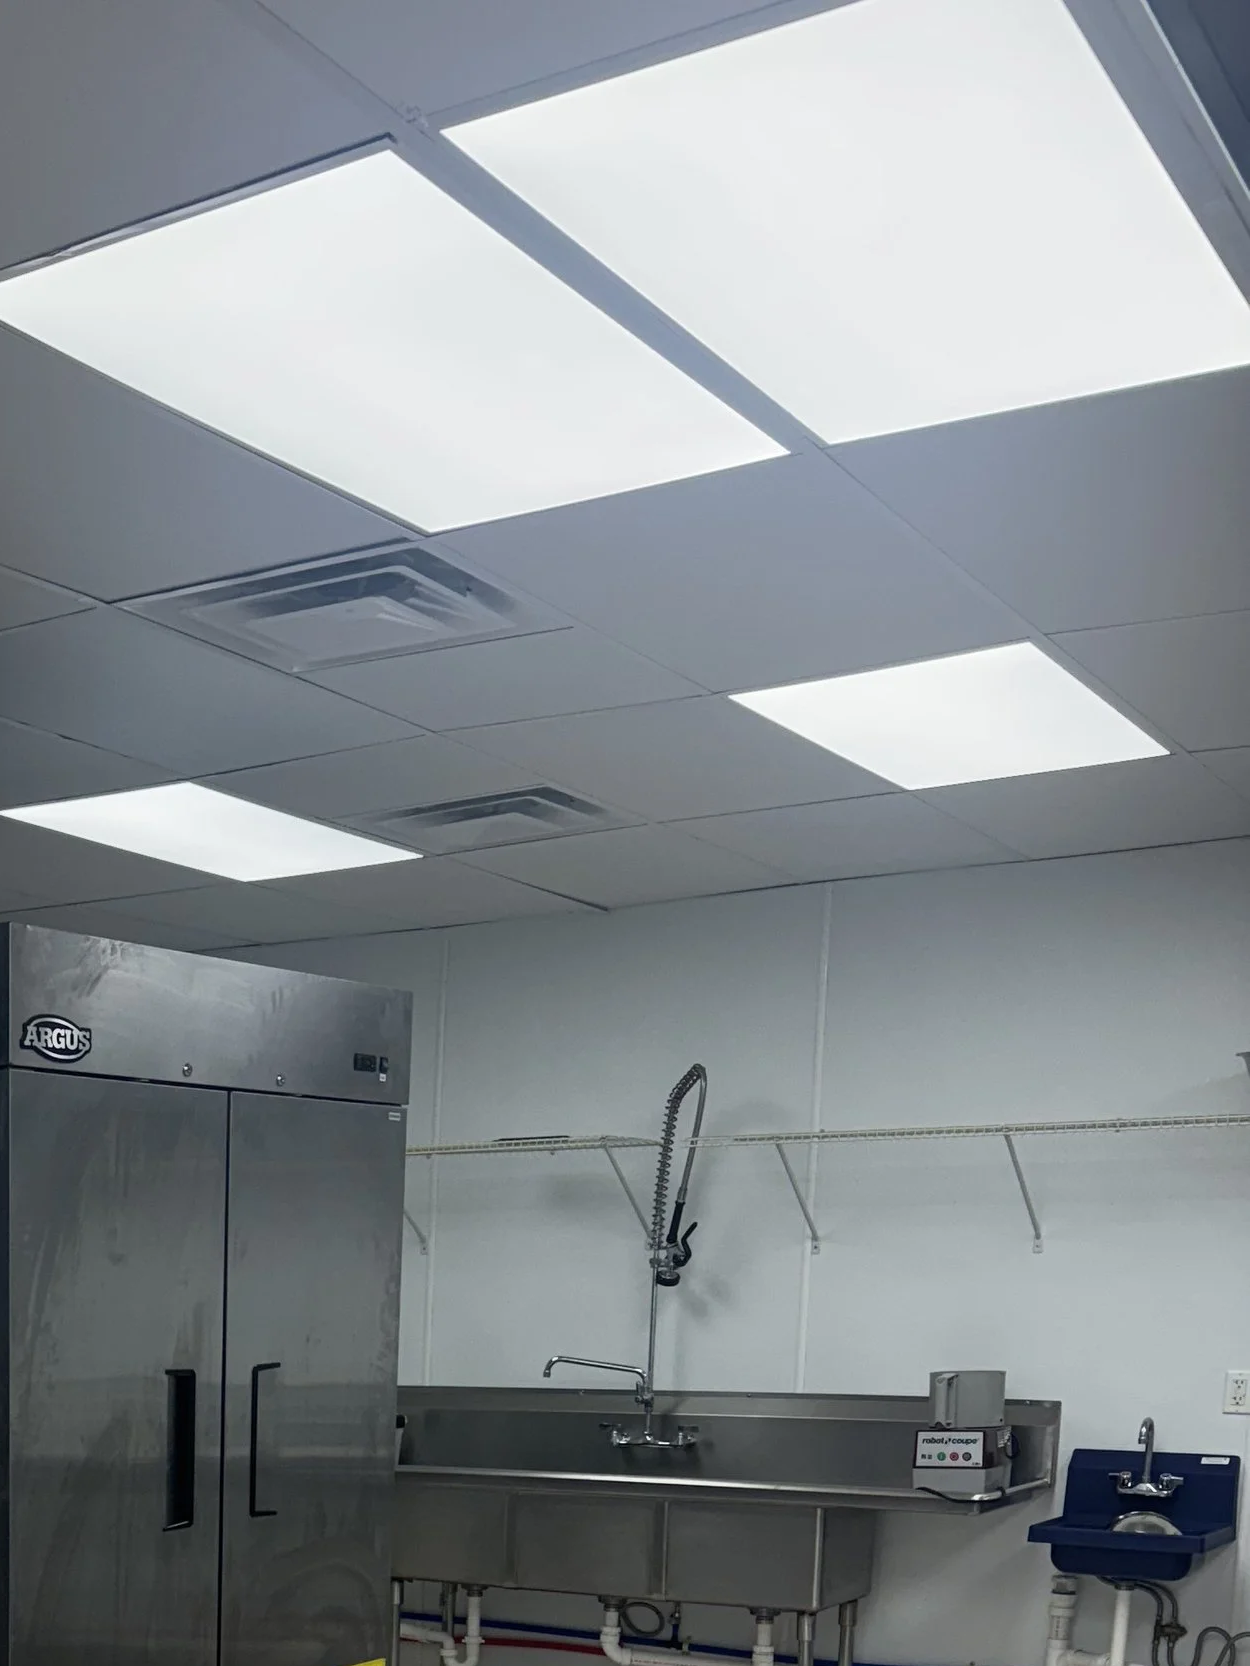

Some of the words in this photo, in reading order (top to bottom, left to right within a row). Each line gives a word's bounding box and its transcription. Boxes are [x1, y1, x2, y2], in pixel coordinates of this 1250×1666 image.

[23, 1025, 91, 1051] ARGUS
[922, 1436, 944, 1445] robot
[951, 1437, 978, 1446] coupe
